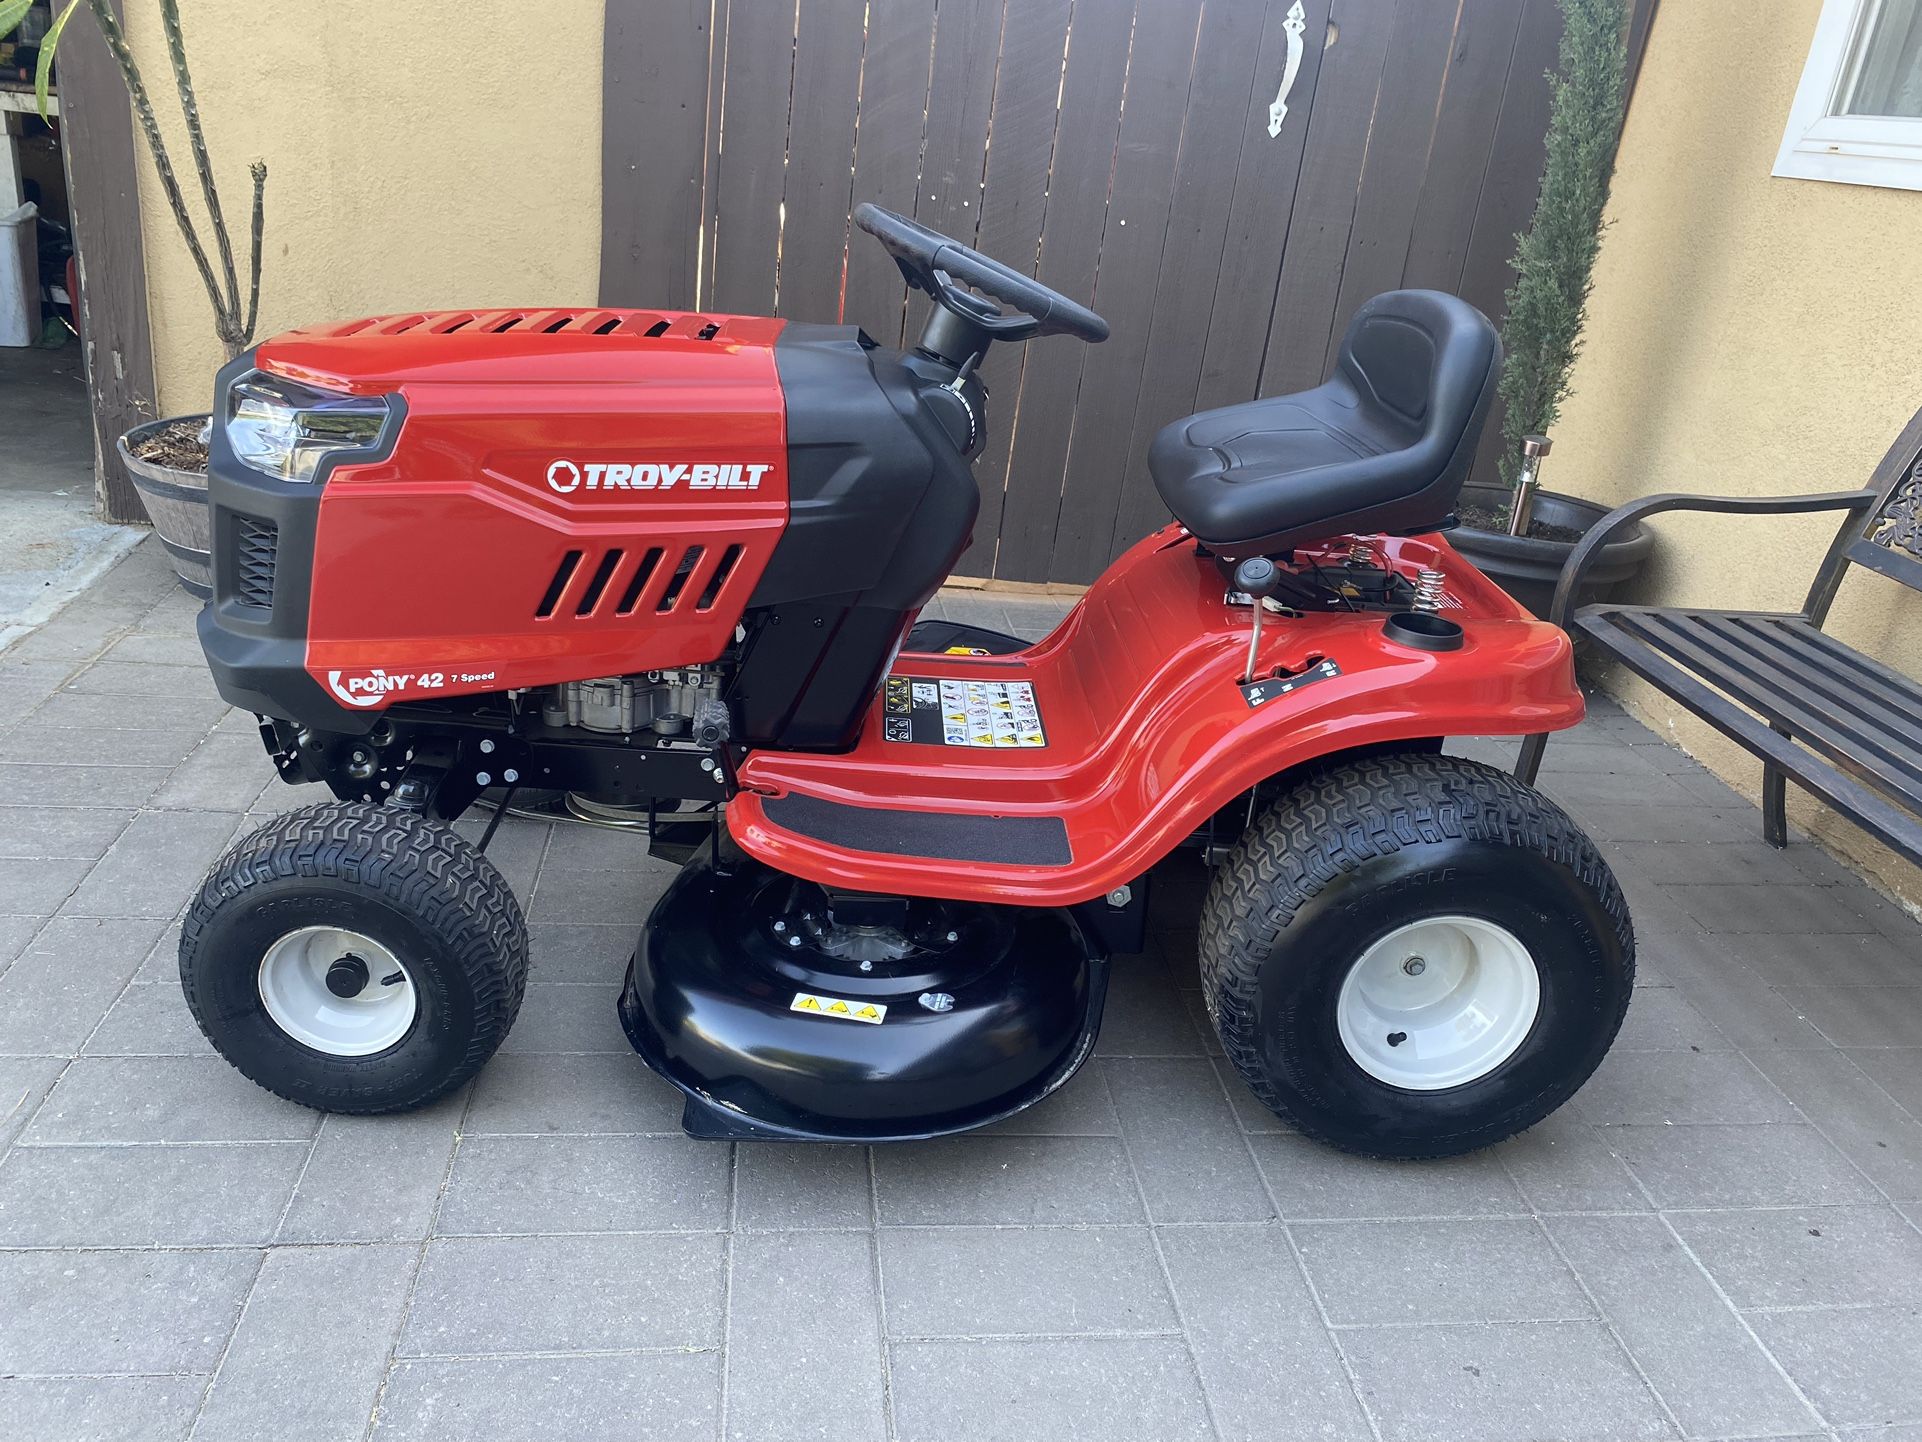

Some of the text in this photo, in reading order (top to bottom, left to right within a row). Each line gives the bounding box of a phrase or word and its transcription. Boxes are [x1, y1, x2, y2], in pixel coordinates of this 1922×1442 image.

[583, 464, 769, 490] TROY-BILT
[348, 671, 495, 693] PONY 42 7 Speed
